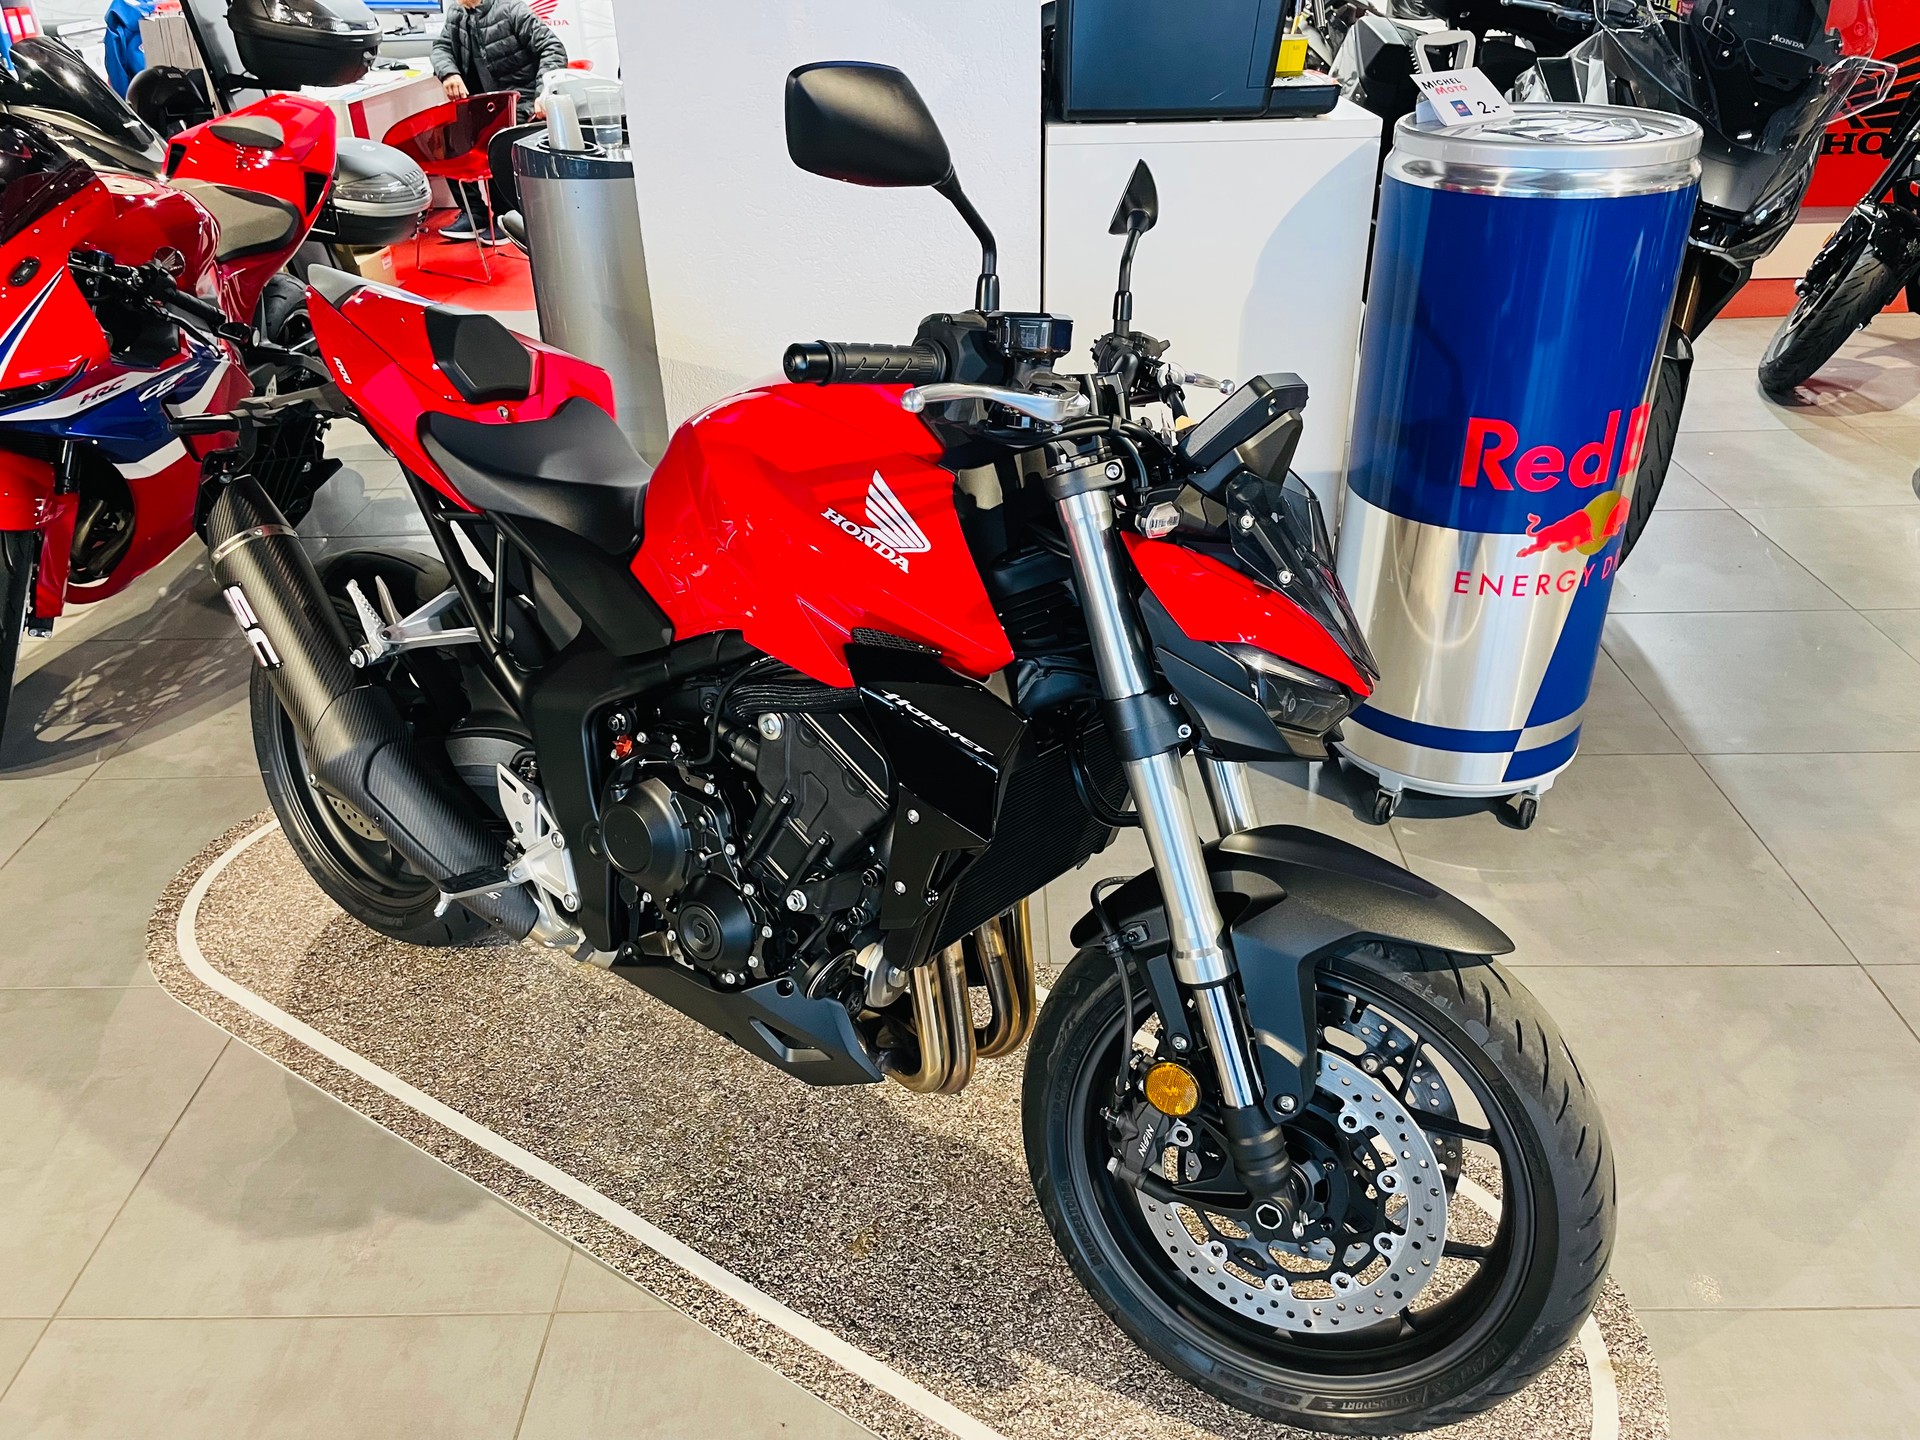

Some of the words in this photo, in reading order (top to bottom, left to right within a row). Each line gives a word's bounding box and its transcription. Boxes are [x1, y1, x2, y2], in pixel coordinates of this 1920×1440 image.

[1770, 33, 1805, 50] HONDA
[1421, 77, 1462, 91] MICHEL
[1435, 84, 1468, 96] MOTO
[1820, 131, 1886, 155] HO
[333, 356, 353, 385] 1000
[79, 377, 127, 405] HRC
[1459, 409, 1622, 493] Red
[820, 507, 909, 574] HONDA
[1453, 565, 1596, 597] ENERGY
[1137, 1123, 1155, 1158] NISSIN
